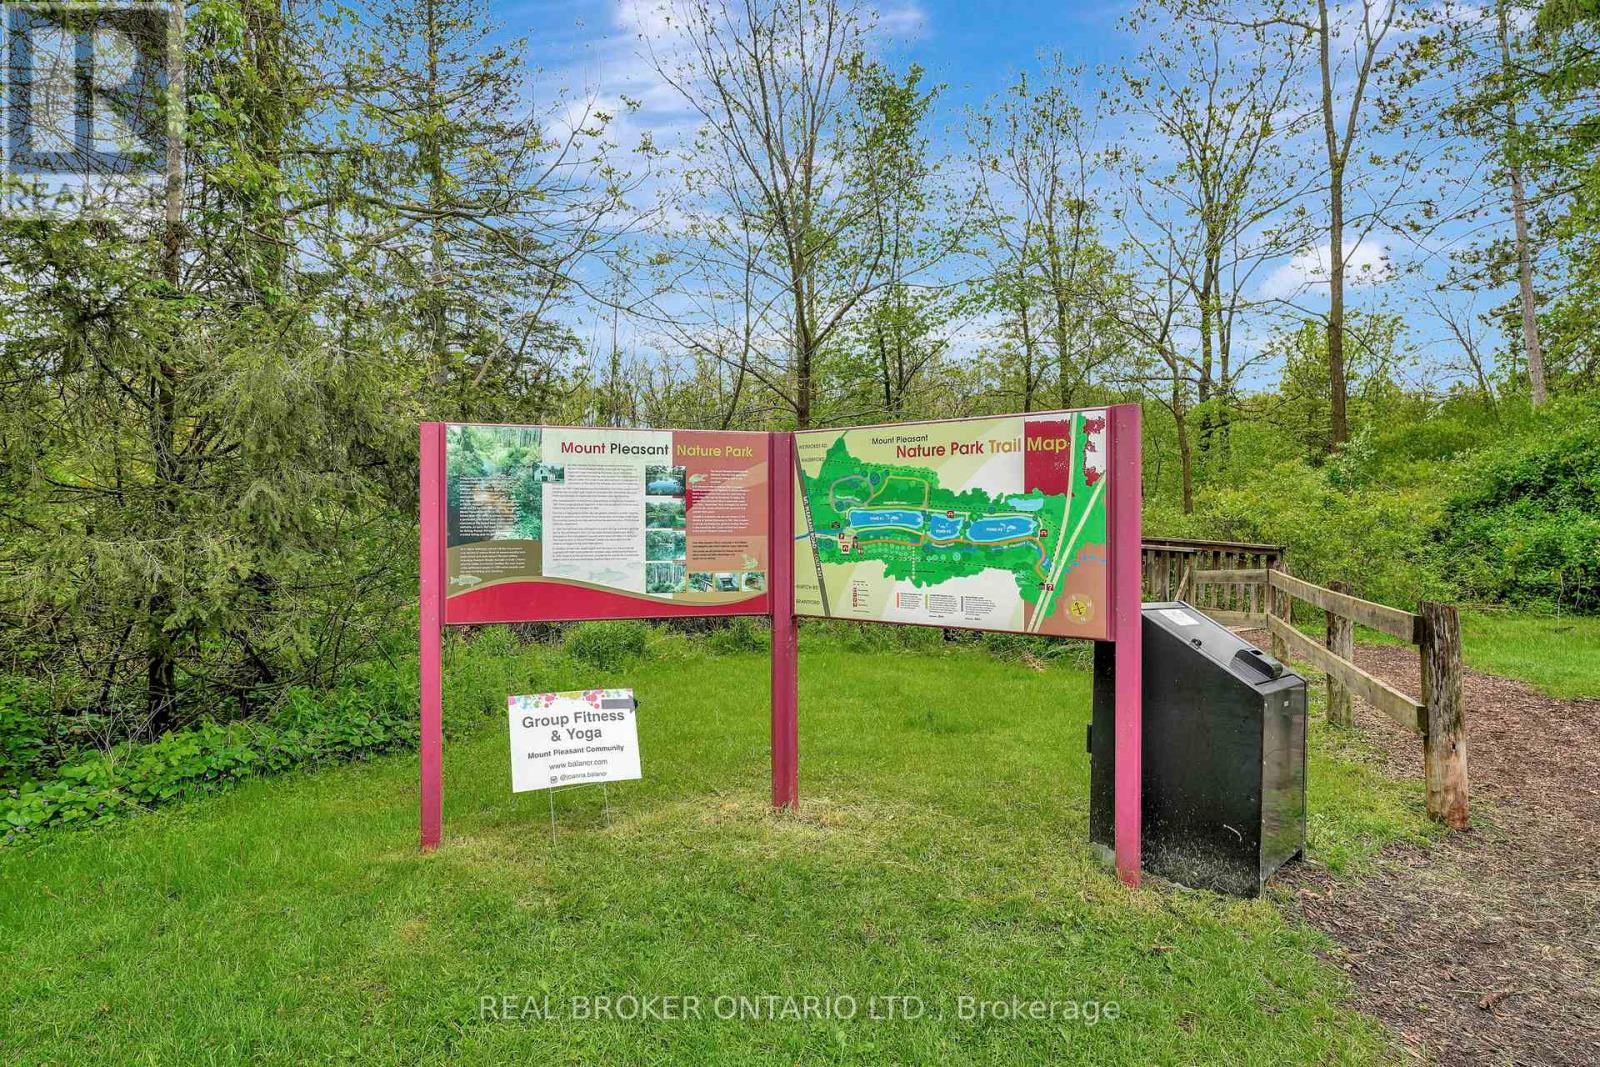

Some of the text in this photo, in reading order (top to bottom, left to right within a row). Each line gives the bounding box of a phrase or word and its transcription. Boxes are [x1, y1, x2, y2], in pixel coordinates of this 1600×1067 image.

[872, 434, 928, 445] Mount Pleasant
[896, 436, 1068, 458] Nature Park Trail Map
[561, 441, 753, 457] Mount Pleasant Nature Park
[522, 711, 625, 728] Group Fitness
[551, 728, 602, 742] & Yoga
[528, 744, 624, 760] Mount Pleasant Community
